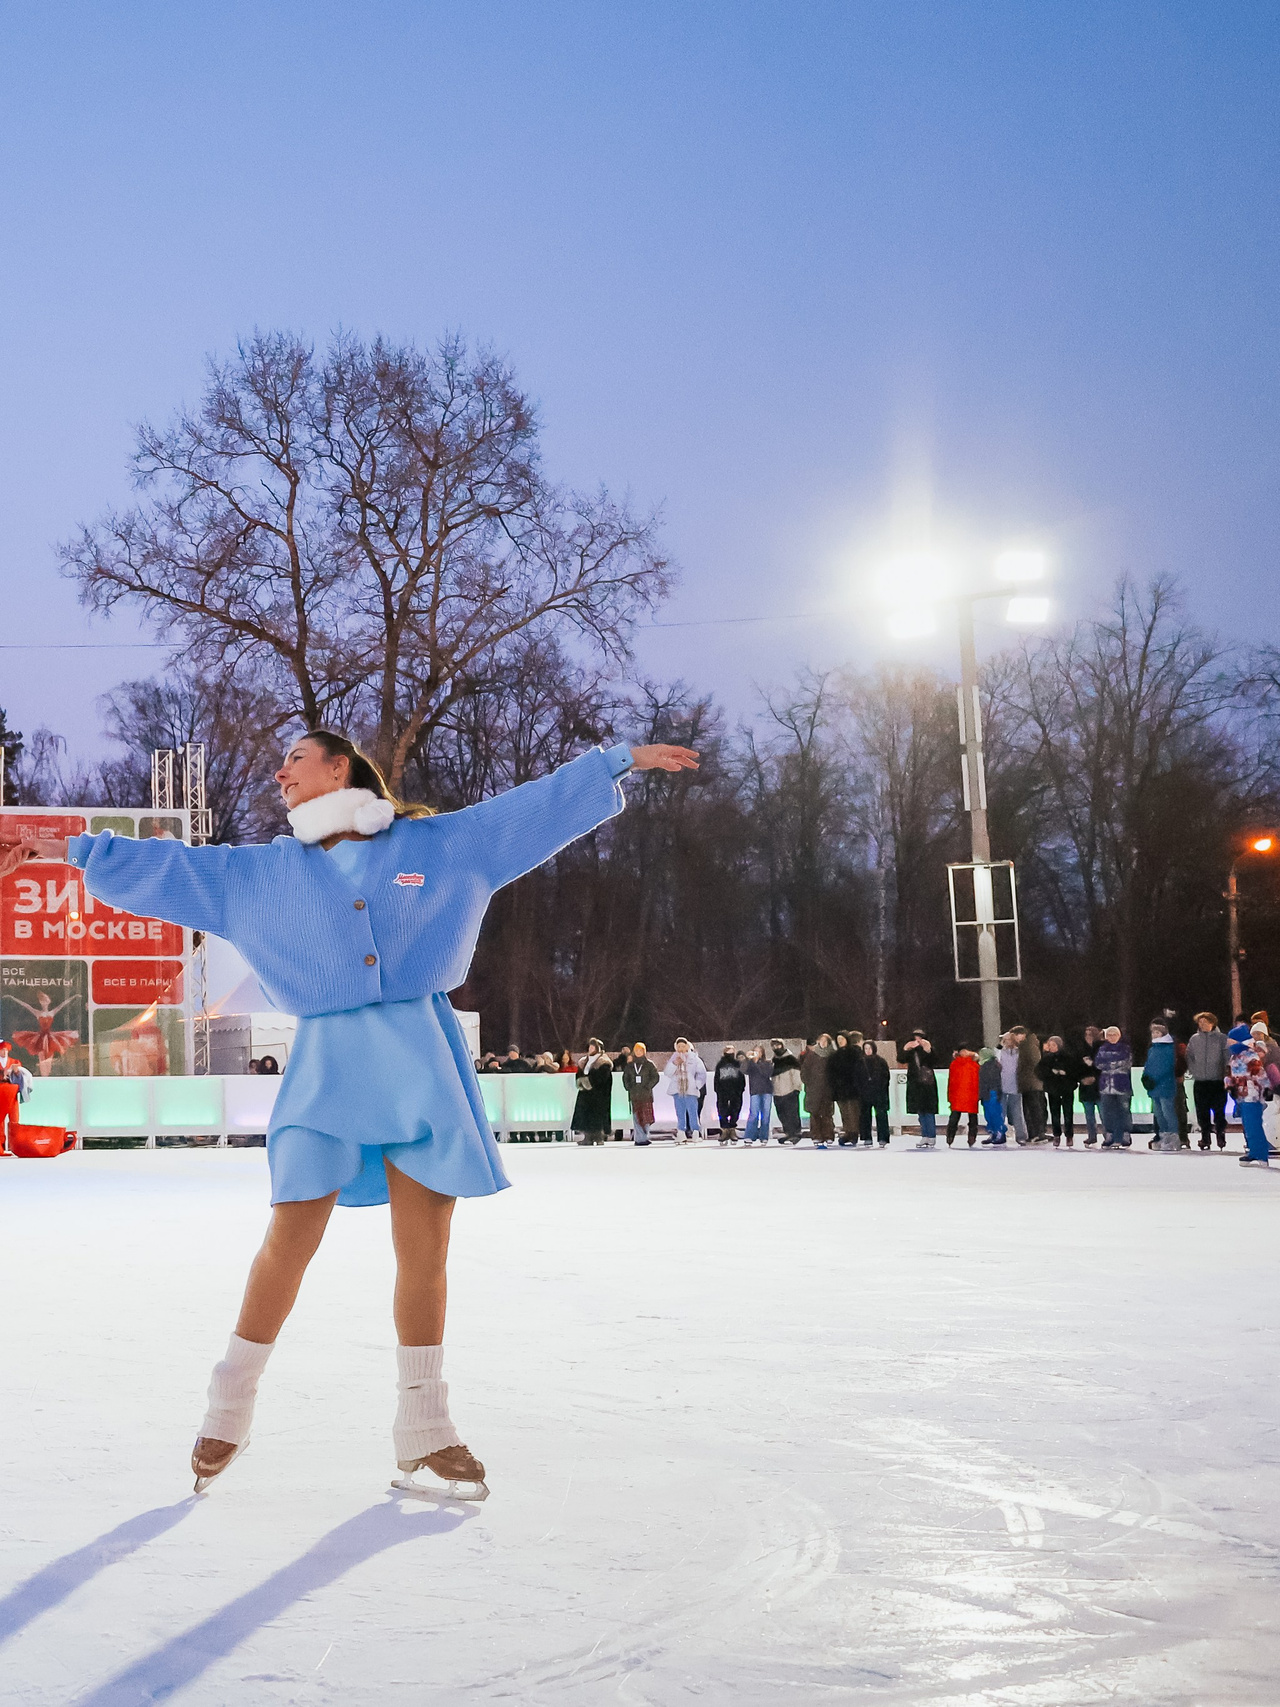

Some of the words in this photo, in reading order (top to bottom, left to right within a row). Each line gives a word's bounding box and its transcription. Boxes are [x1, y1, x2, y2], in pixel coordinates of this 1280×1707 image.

[14, 879, 123, 914] ЗИ
[14, 920, 33, 939] В
[43, 920, 163, 940] МОСКВЕ
[2, 968, 26, 976] ВСЕ
[2, 978, 74, 987] ТАНЦЕВАТЬ!
[104, 978, 126, 986] ВСЕ
[129, 978, 137, 986] В
